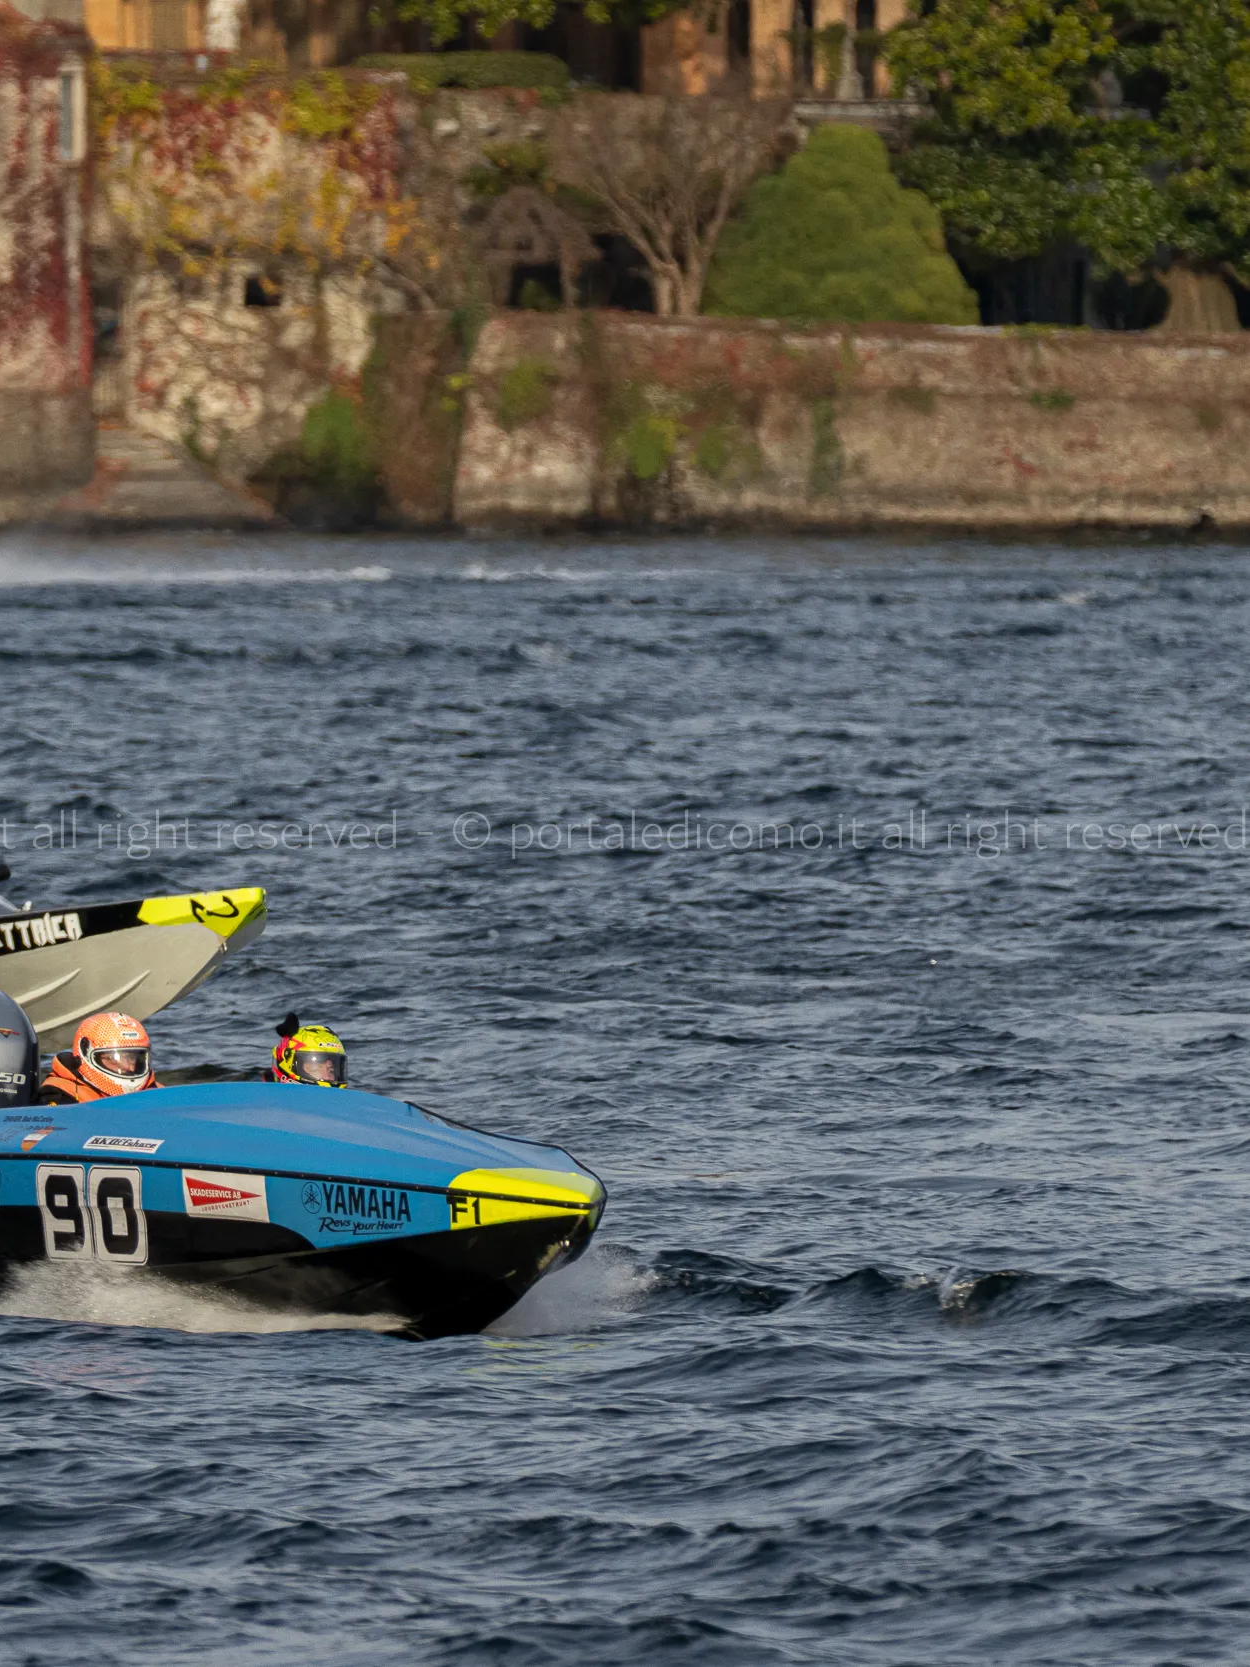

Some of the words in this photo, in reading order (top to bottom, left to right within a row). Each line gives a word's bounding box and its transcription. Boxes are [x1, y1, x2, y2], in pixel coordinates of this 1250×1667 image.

[190, 1187, 232, 1199] SKADESERVICE
[322, 1183, 412, 1222] YAMAHA
[447, 1194, 482, 1225] F1
[45, 1174, 139, 1255] 90
